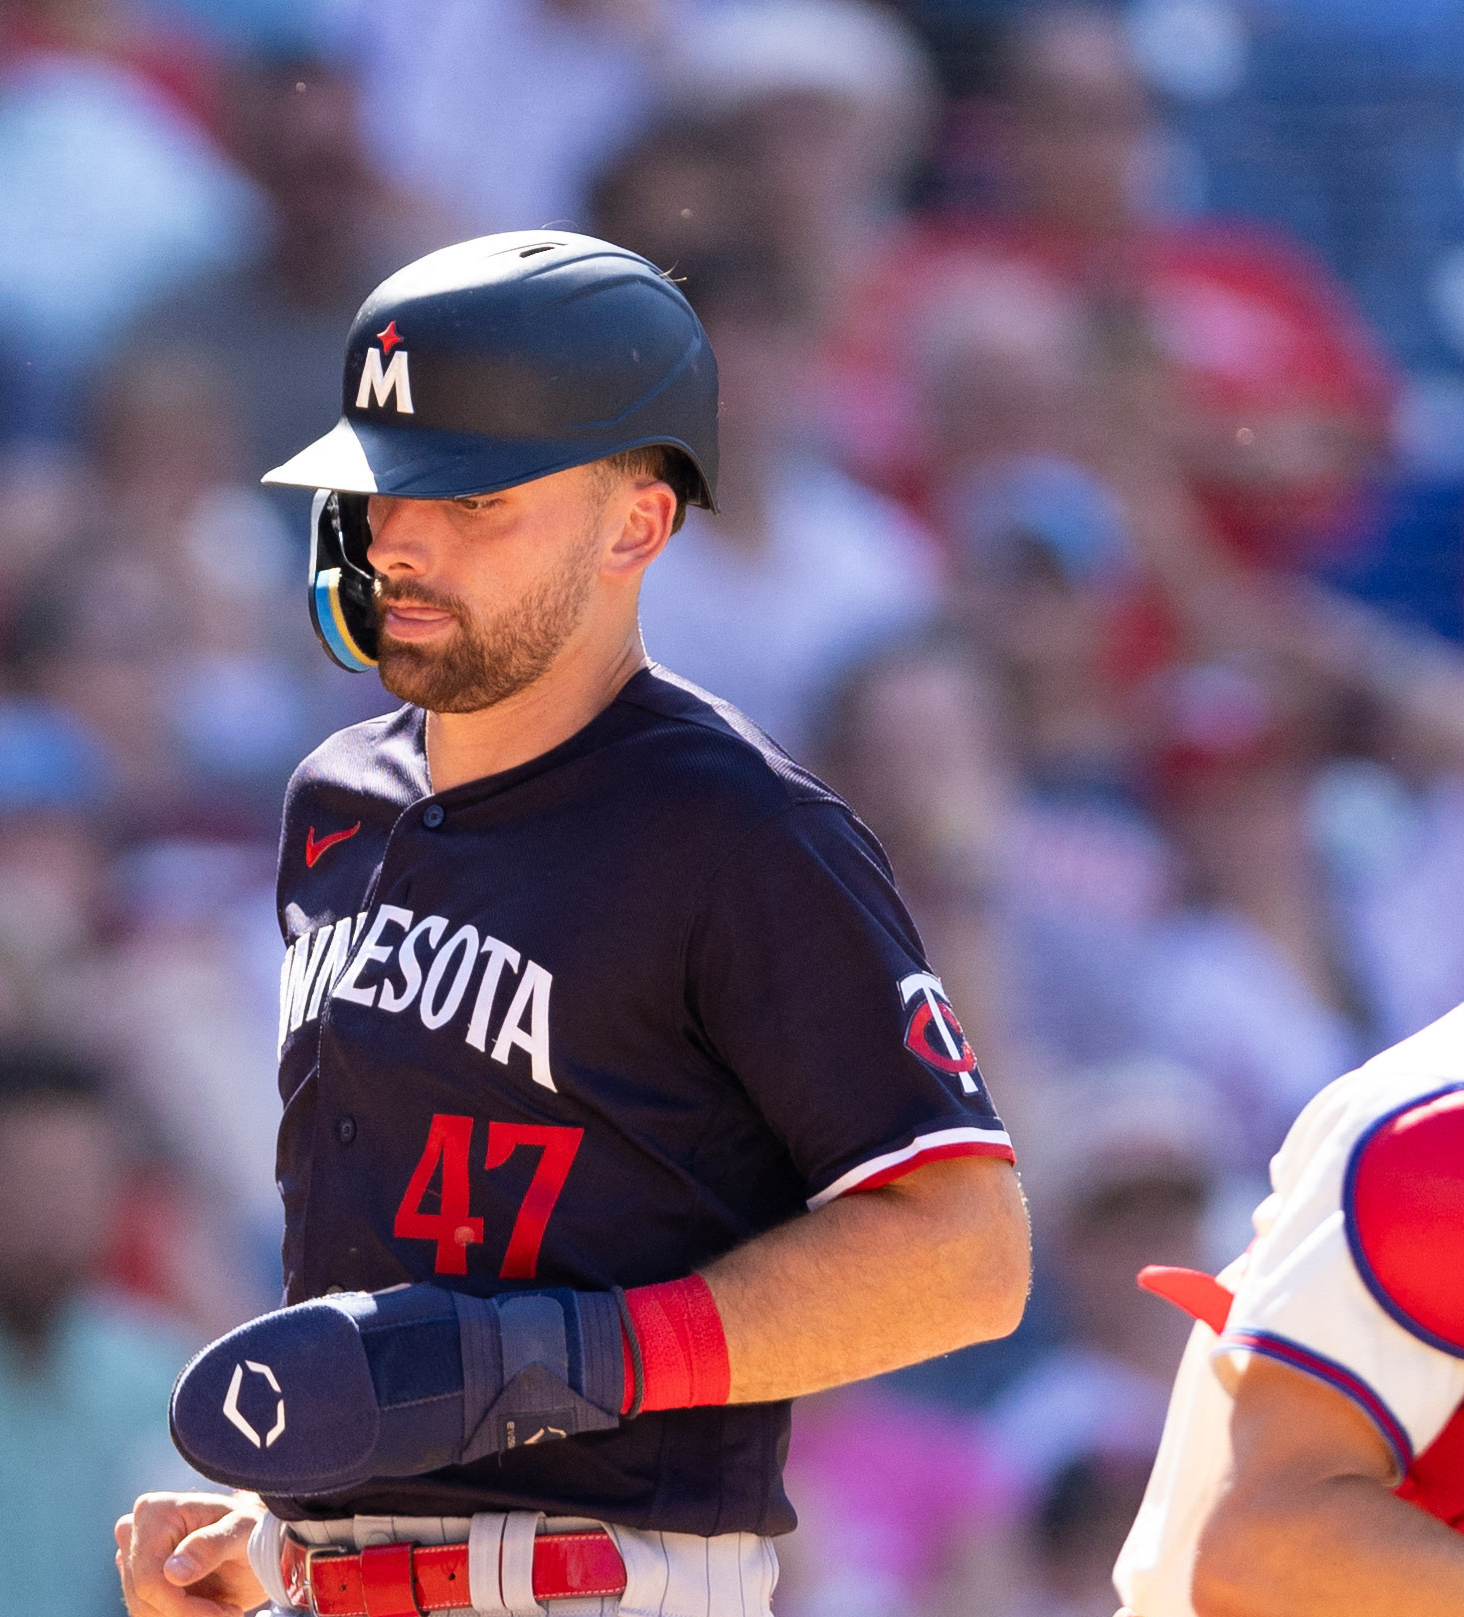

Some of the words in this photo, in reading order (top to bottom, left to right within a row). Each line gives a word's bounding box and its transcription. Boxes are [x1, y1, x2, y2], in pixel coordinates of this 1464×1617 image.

[356, 347, 415, 414] M
[277, 903, 558, 1094] INNESOTA
[393, 1113, 585, 1280] 47
